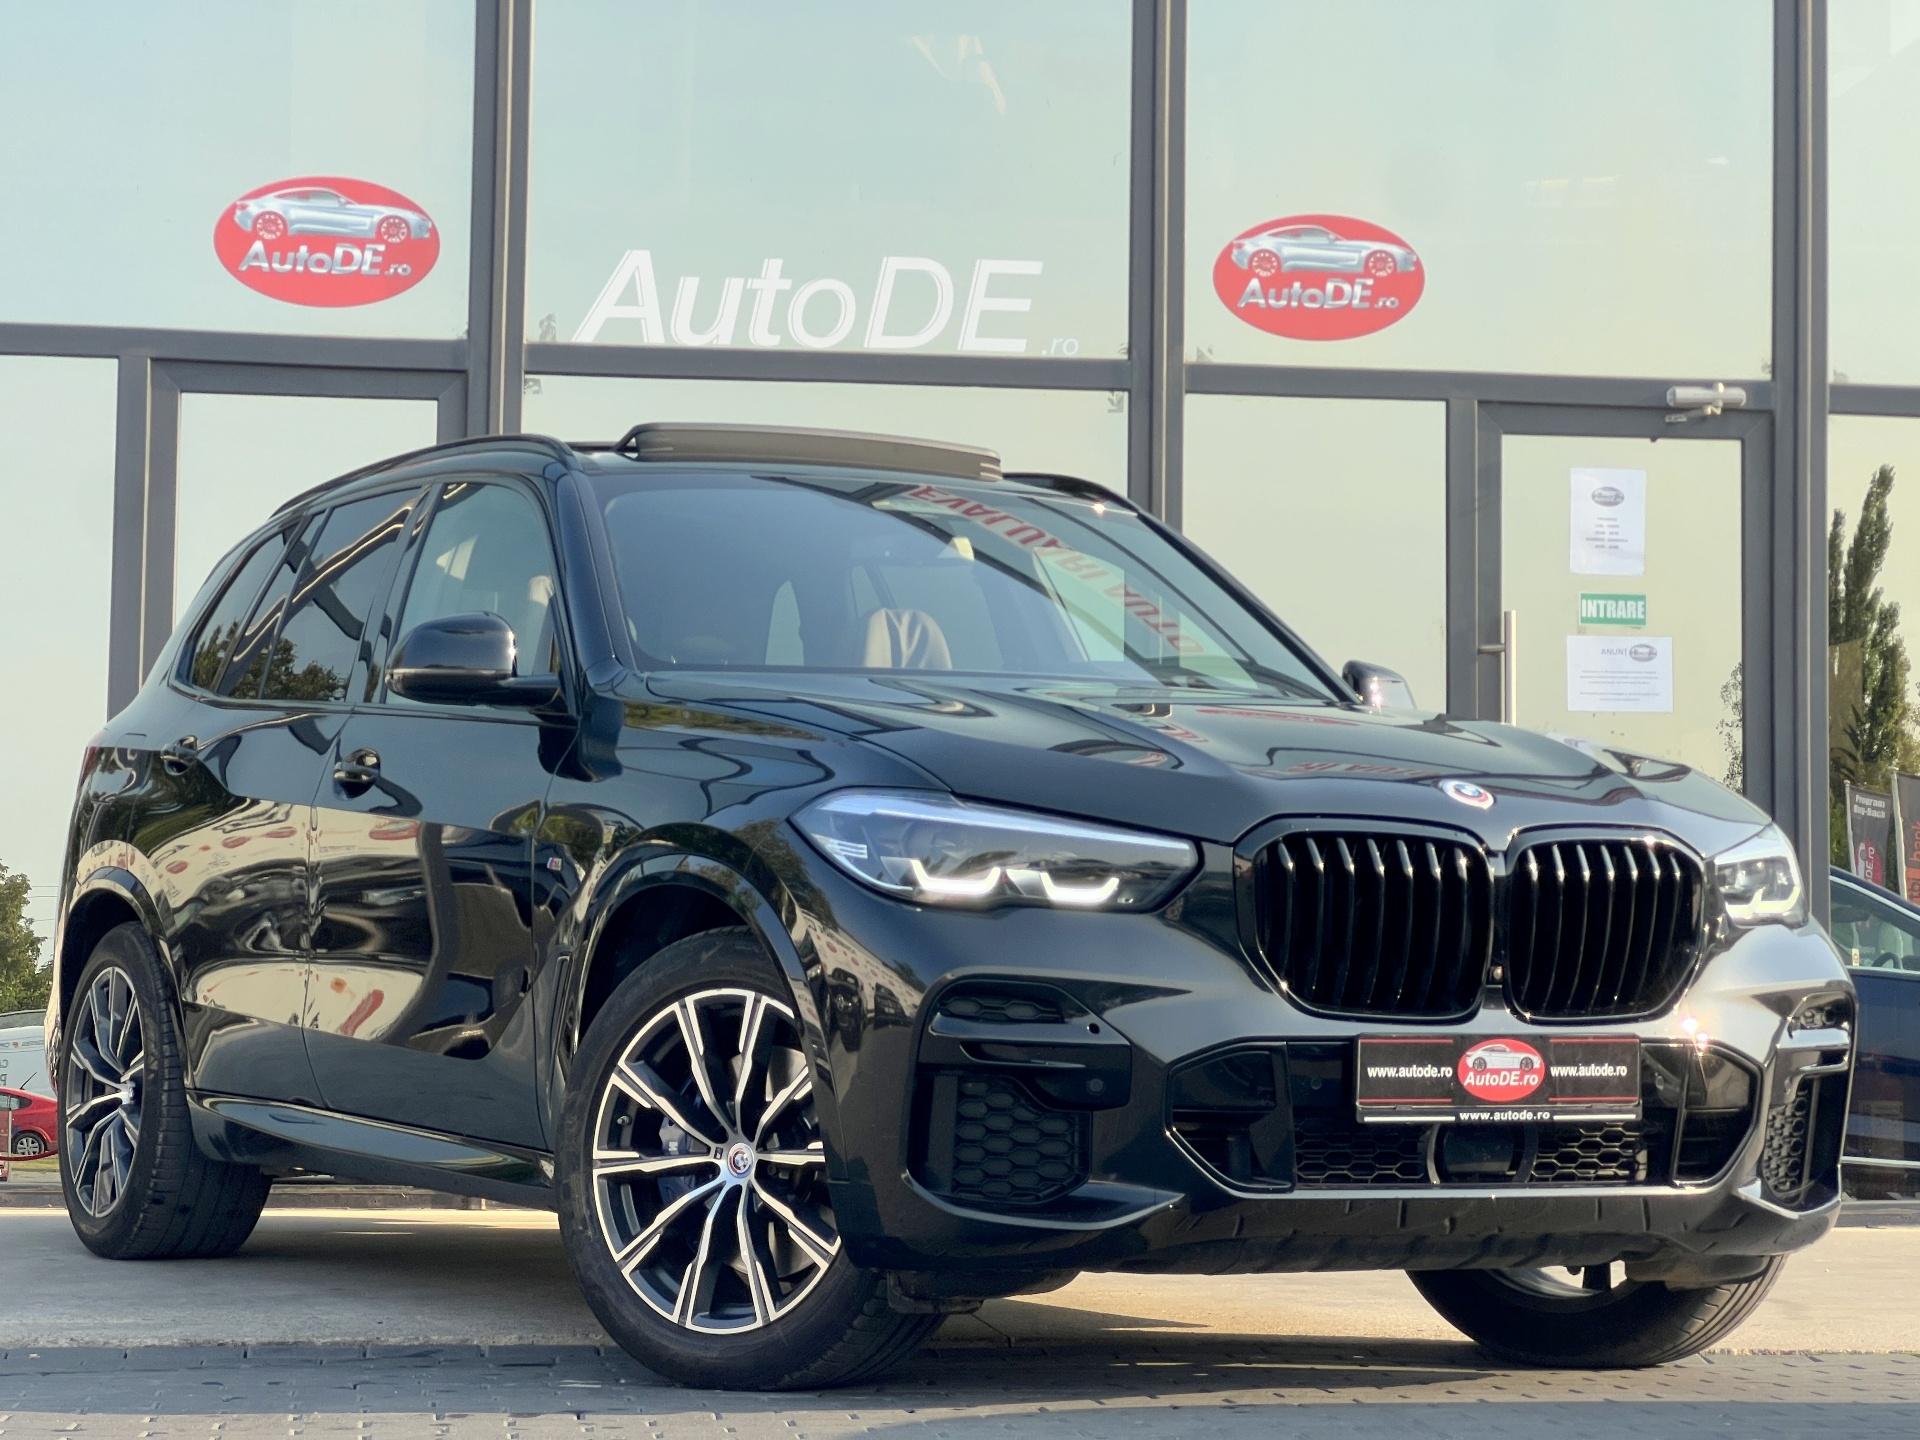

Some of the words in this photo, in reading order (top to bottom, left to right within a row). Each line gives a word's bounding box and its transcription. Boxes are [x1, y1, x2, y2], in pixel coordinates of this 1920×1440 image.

[238, 240, 412, 276] AutoDE.ro
[1238, 278, 1399, 309] AutoDE.ro
[1581, 599, 1645, 619] INTRARE
[1367, 1064, 1453, 1078] www.autode.ro
[1464, 1070, 1539, 1087] AutoDE.ro
[1550, 1062, 1627, 1077] www.autode.ro
[1459, 1110, 1550, 1121] www.autode.ro
